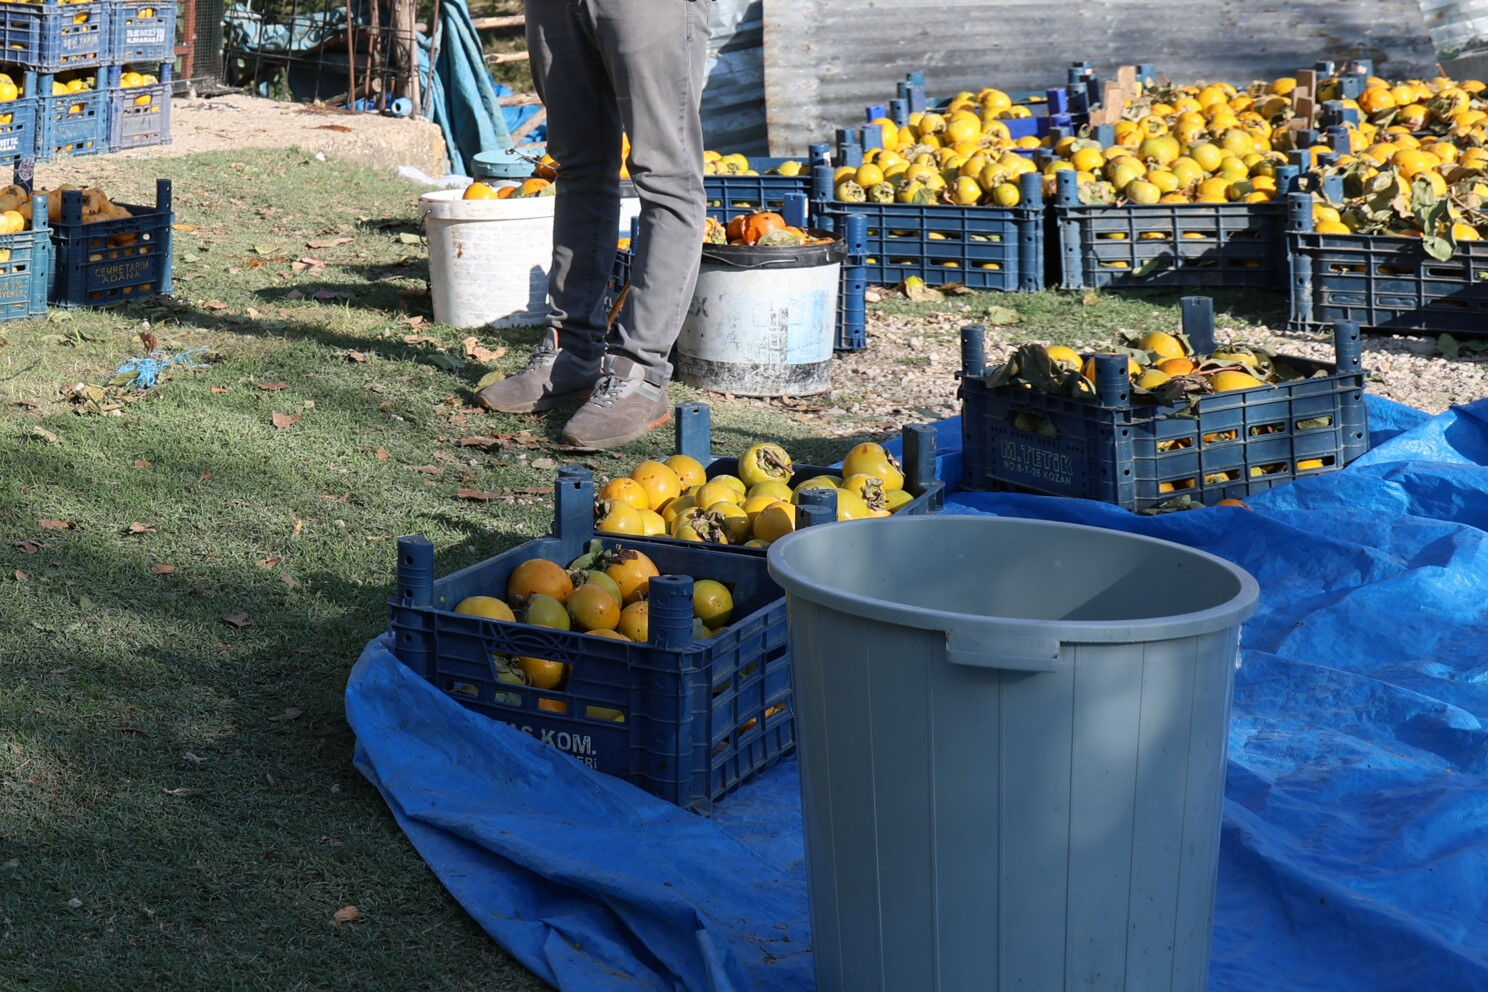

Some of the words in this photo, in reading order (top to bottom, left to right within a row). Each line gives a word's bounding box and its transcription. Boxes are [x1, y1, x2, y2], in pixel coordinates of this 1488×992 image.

[102, 271, 141, 284] ADANA
[1043, 471, 1073, 486] KOZAN
[541, 728, 597, 755] KOM.
